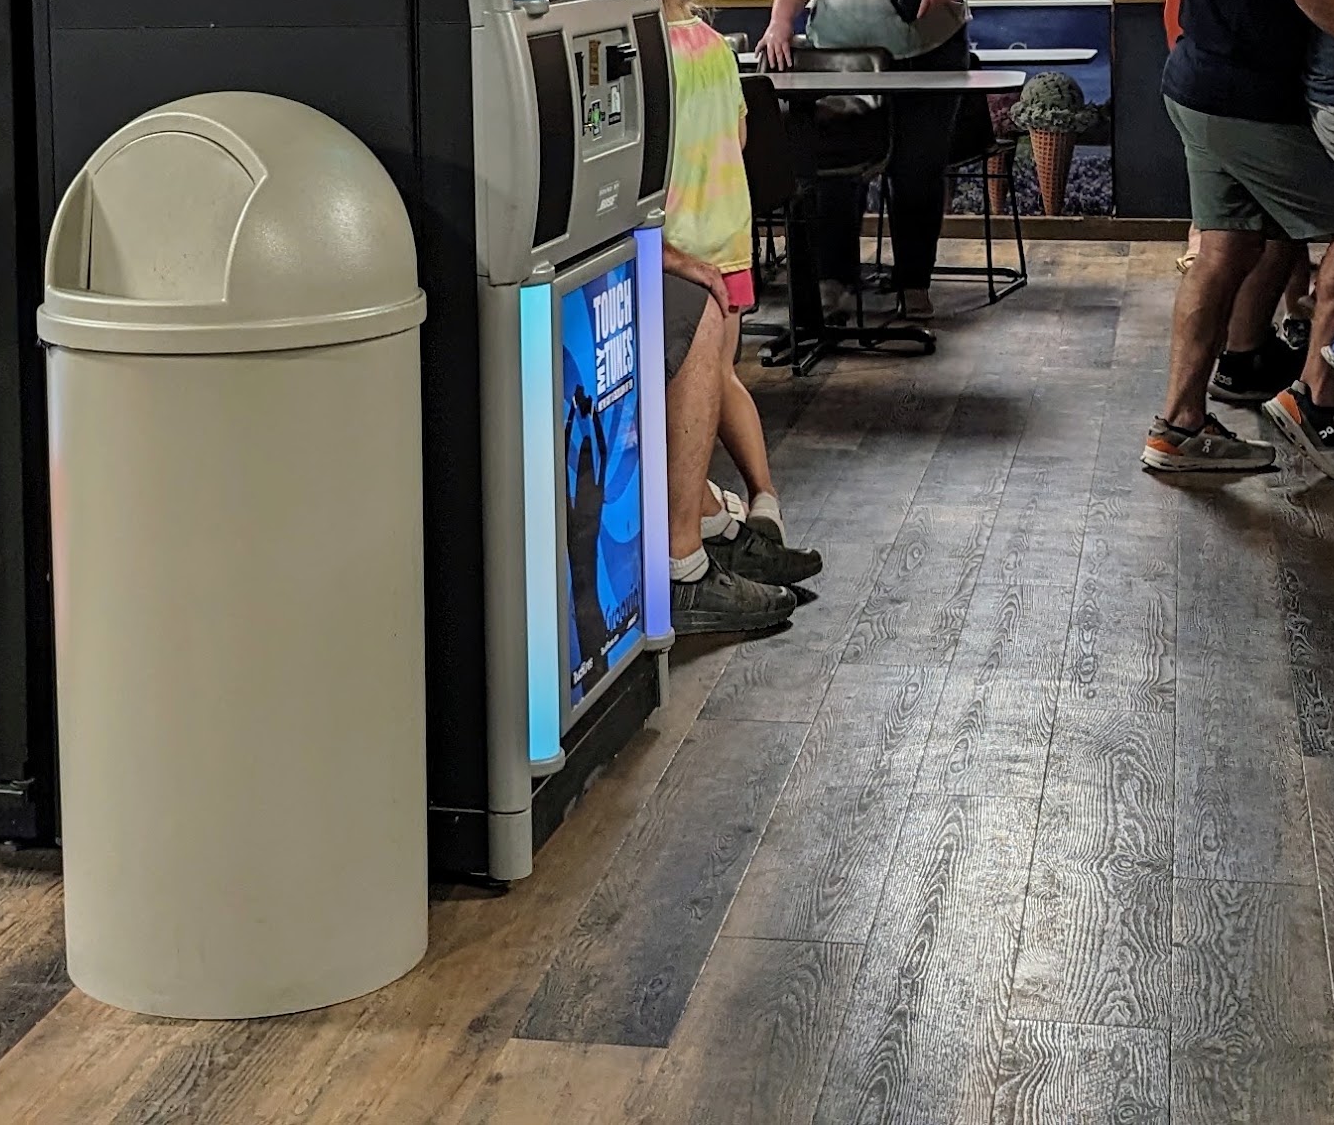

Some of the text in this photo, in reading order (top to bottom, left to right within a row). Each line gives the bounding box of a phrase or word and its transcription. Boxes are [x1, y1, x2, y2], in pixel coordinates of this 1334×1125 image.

[593, 277, 633, 344] TOUCH
[596, 347, 607, 396] MY
[604, 325, 634, 389] TUNES
